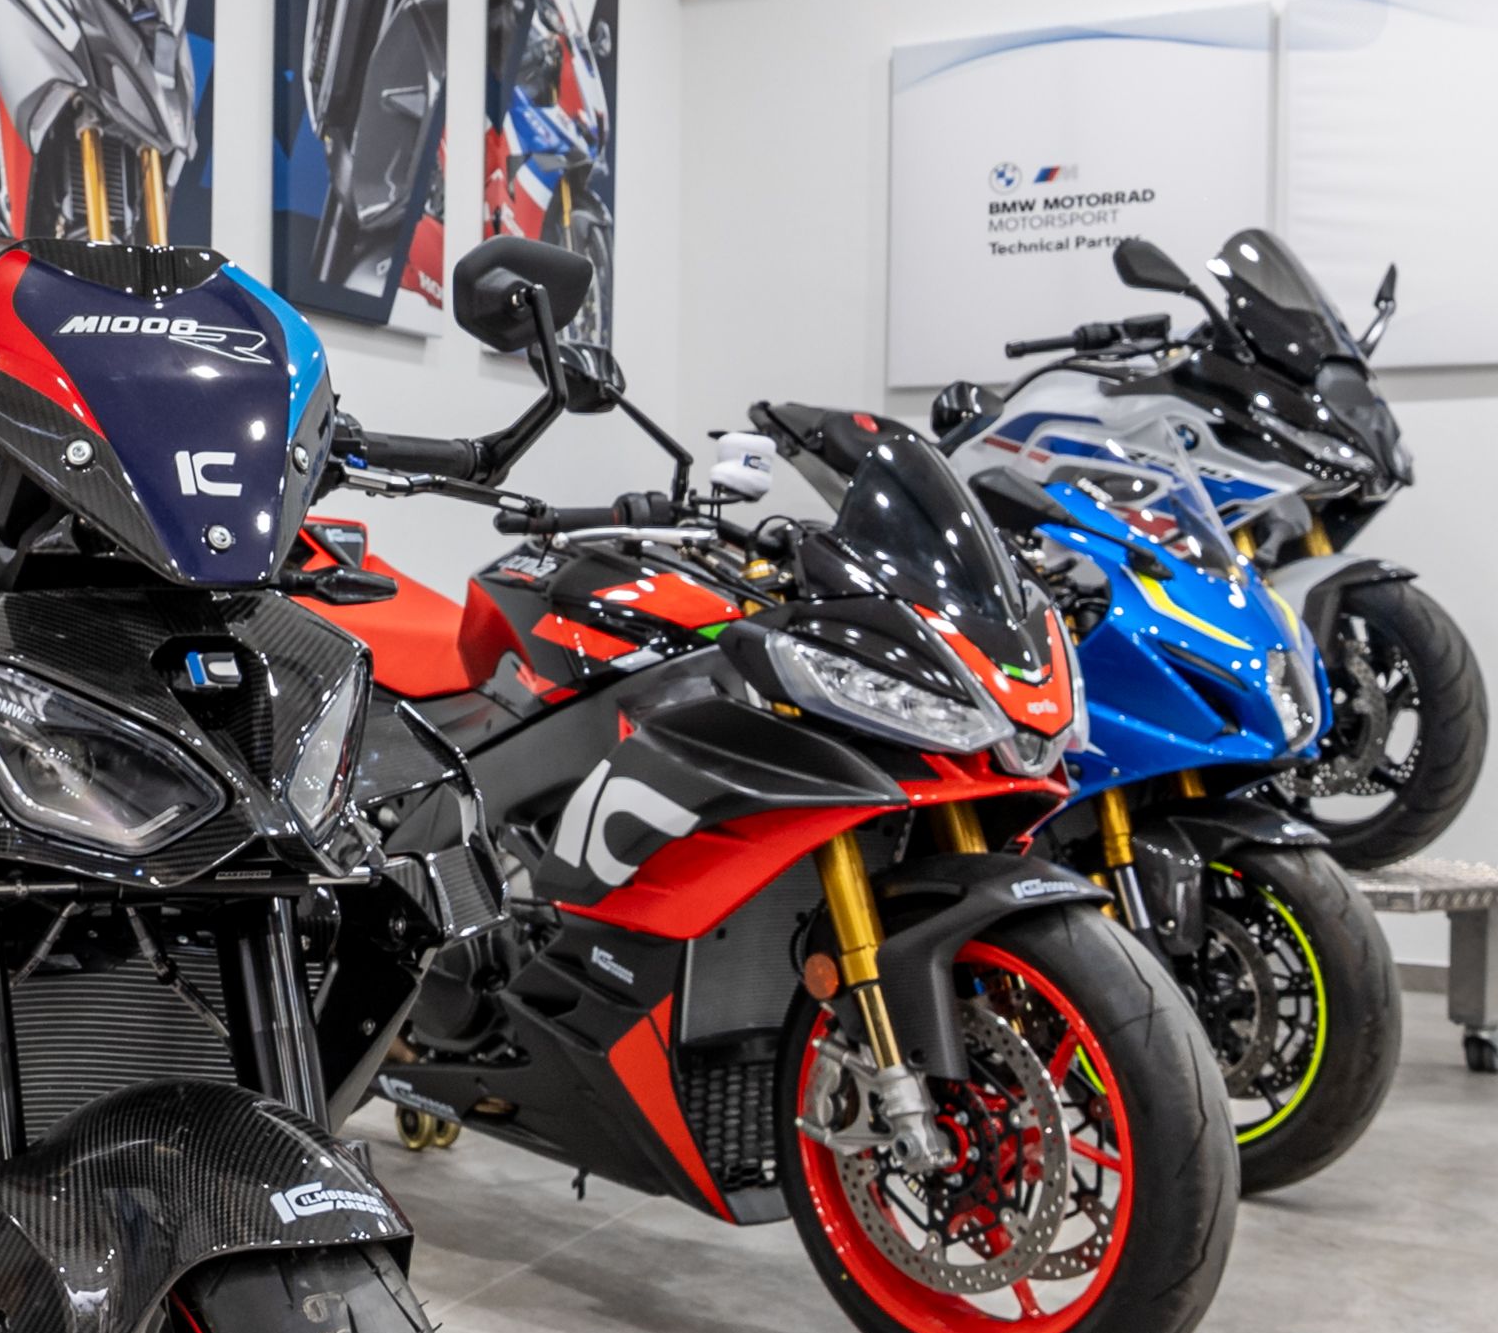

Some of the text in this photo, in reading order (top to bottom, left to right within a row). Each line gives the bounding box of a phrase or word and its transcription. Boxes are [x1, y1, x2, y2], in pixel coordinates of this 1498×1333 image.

[989, 188, 1155, 215] BMW MOTORRAD
[988, 209, 1119, 232] MOTORSPORT
[990, 236, 1070, 255] Technical
